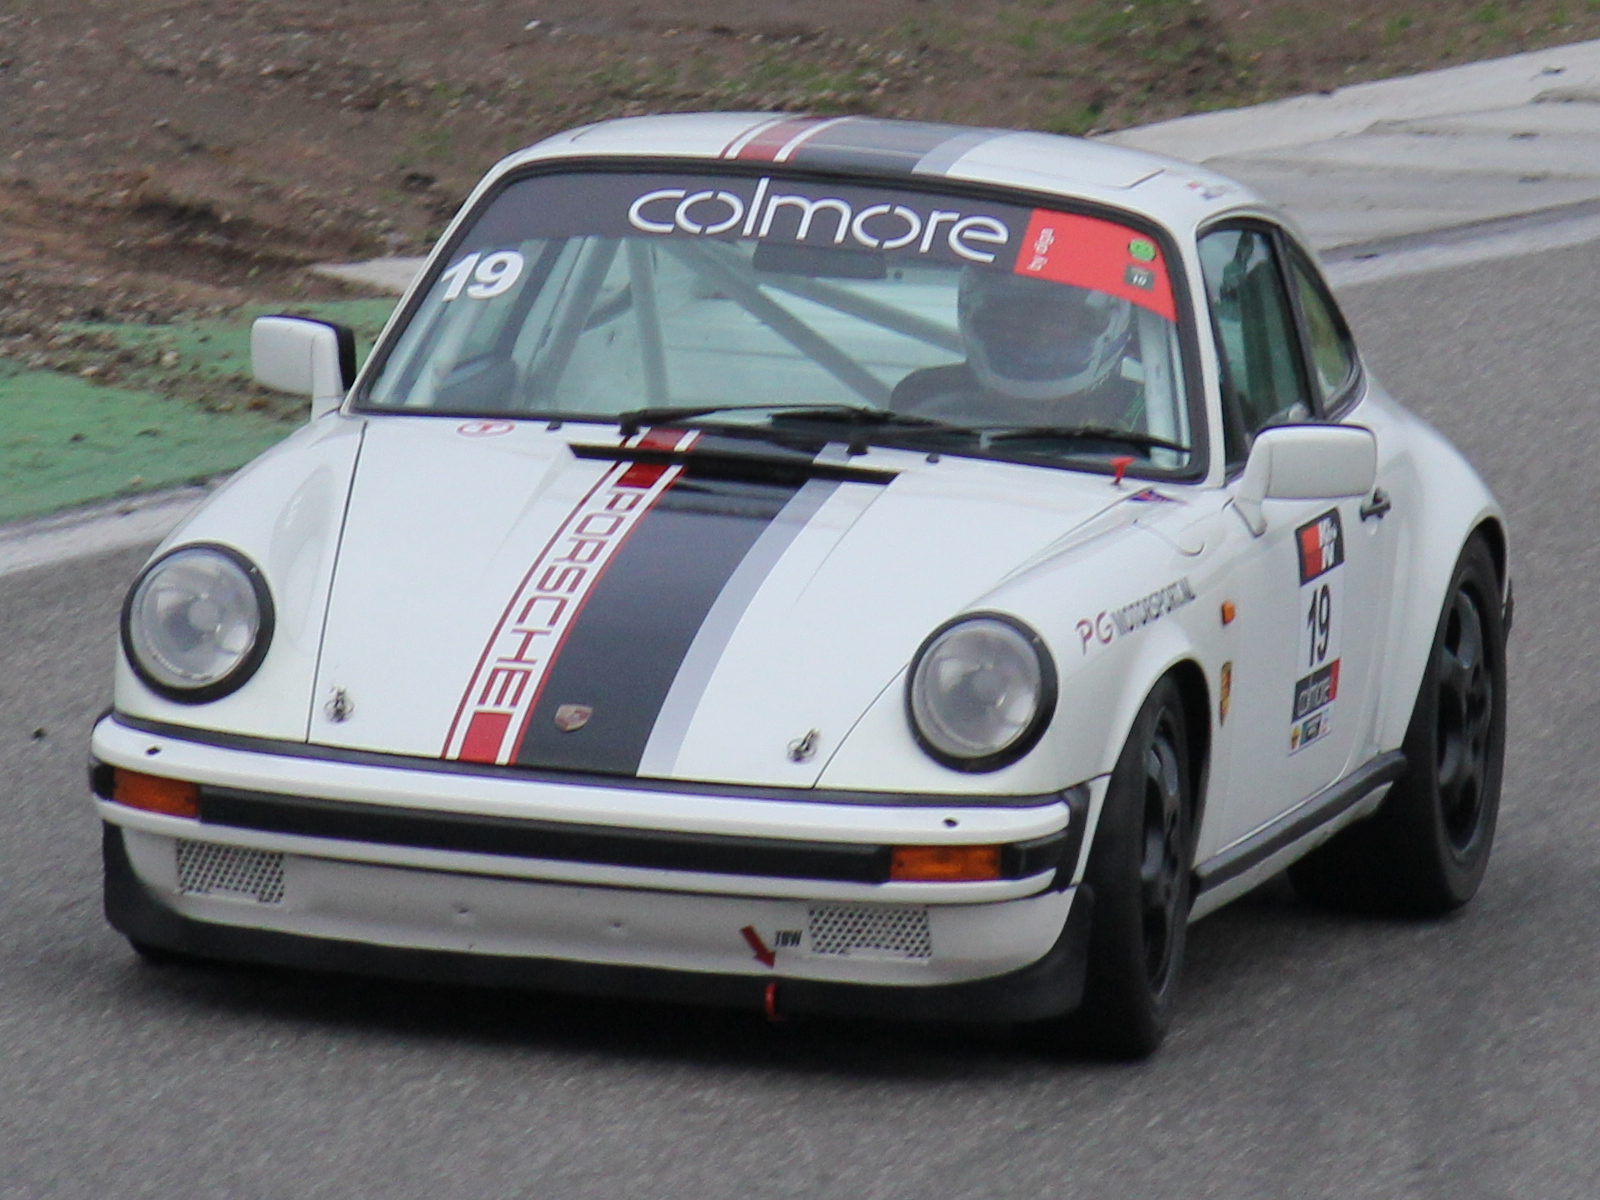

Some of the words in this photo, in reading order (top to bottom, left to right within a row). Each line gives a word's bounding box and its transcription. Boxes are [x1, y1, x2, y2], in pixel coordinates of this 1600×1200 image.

[628, 177, 1009, 263] colmore
[440, 250, 525, 302] 19
[476, 487, 649, 707] PORSCHE
[1307, 584, 1330, 667] 19
